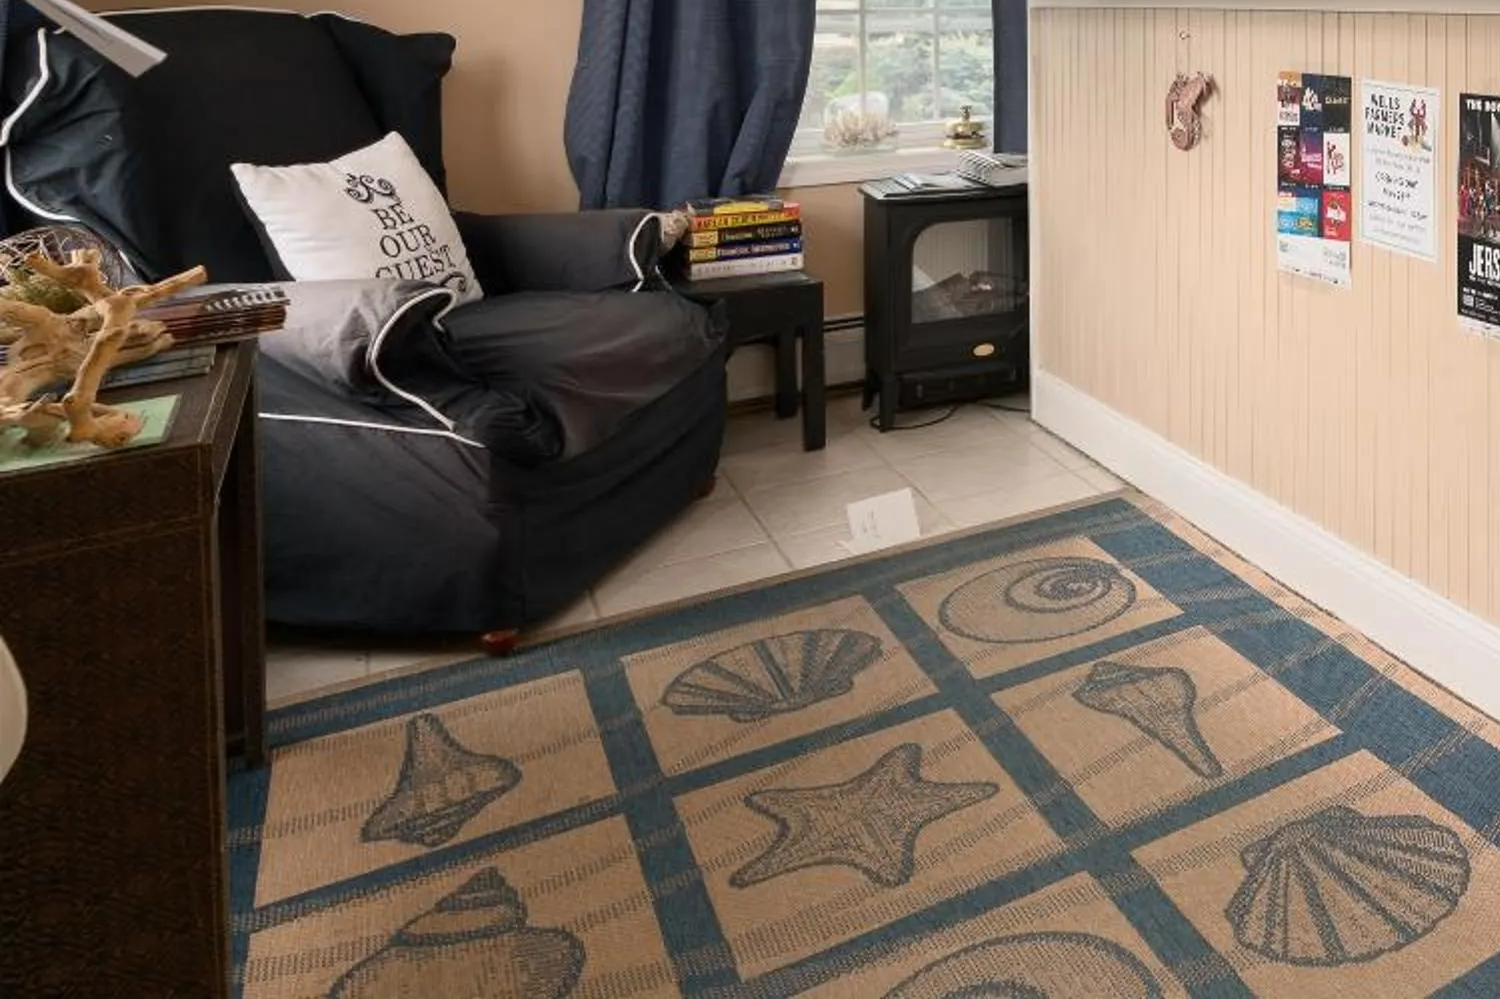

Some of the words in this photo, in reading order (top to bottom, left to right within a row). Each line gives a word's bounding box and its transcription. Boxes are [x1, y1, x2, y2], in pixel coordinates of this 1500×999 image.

[1465, 98, 1483, 111] THE
[371, 201, 414, 230] BE
[379, 224, 437, 258] OUR
